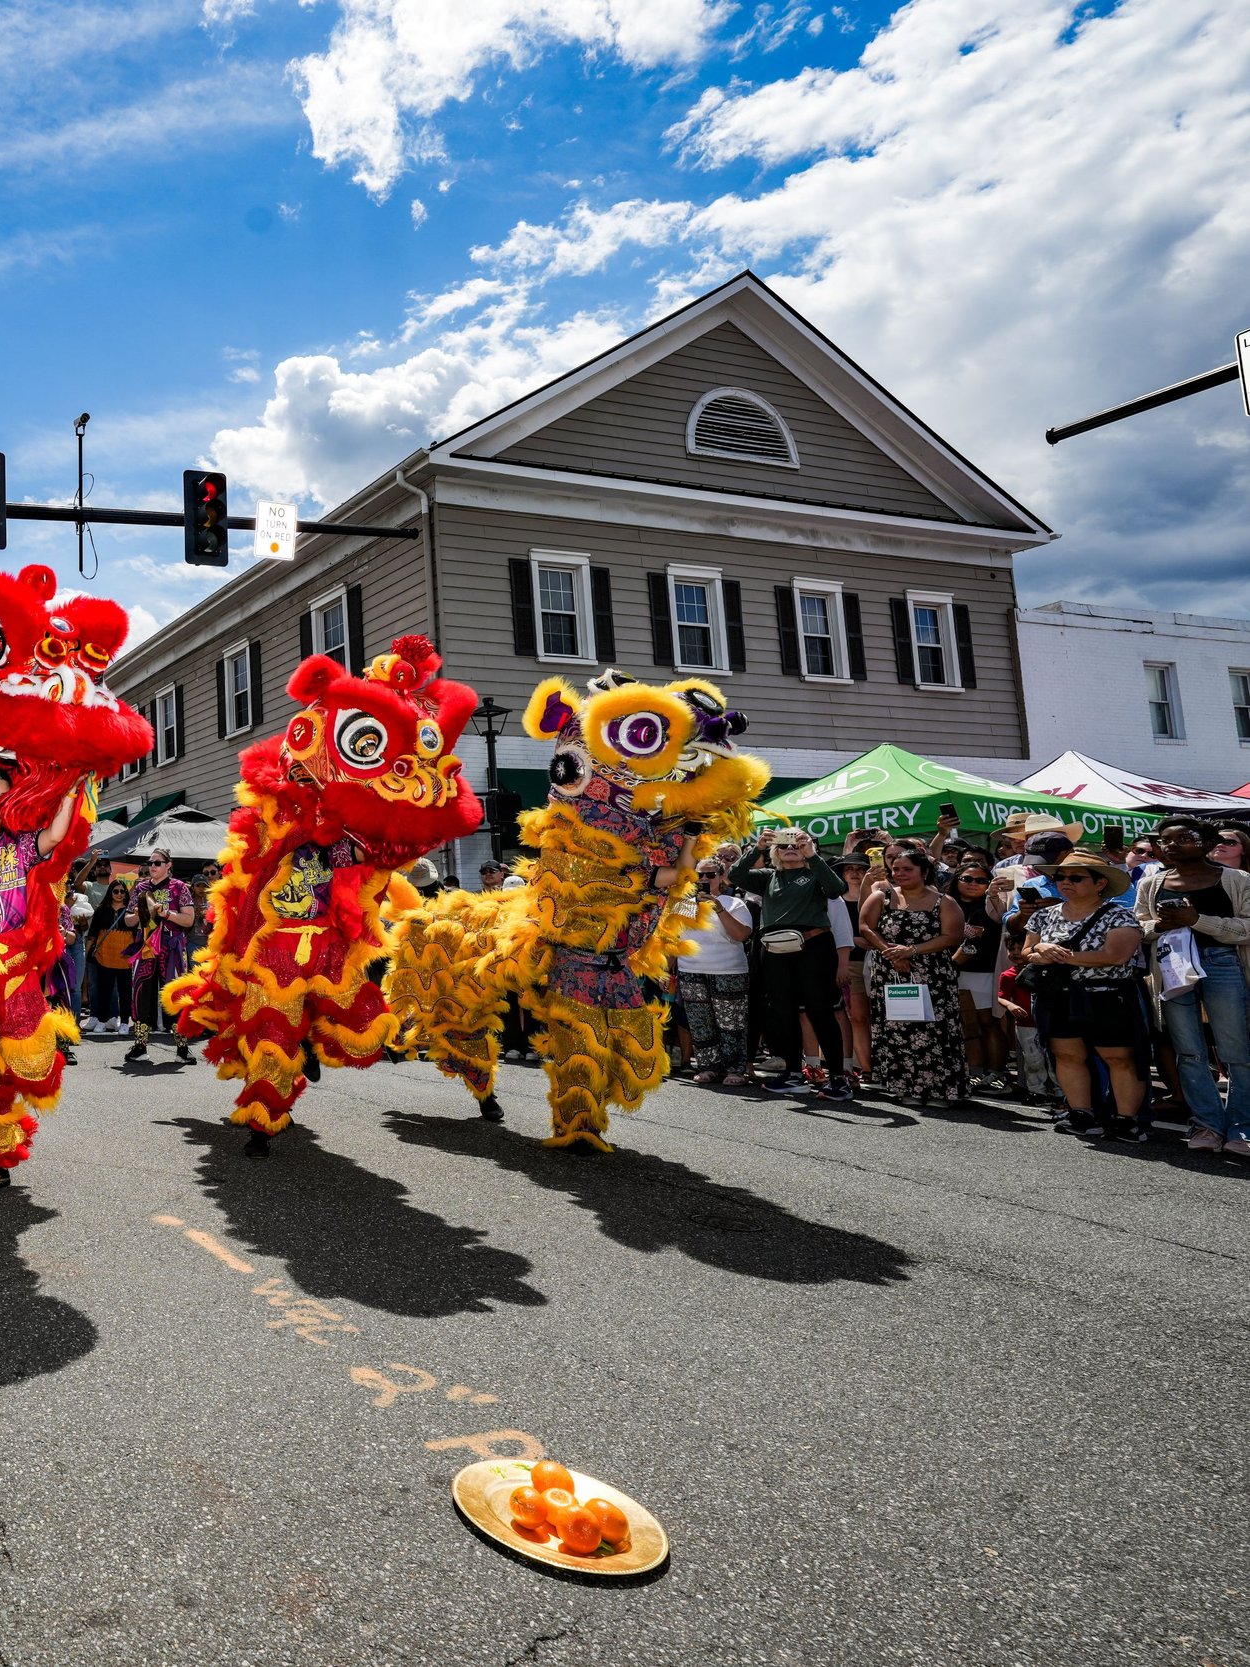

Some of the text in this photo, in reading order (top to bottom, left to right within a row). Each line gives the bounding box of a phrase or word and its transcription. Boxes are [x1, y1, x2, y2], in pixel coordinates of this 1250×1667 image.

[269, 507, 285, 518] NO
[266, 519, 287, 529] TURN
[260, 530, 291, 542] ON RED
[795, 802, 922, 839] OTTERY
